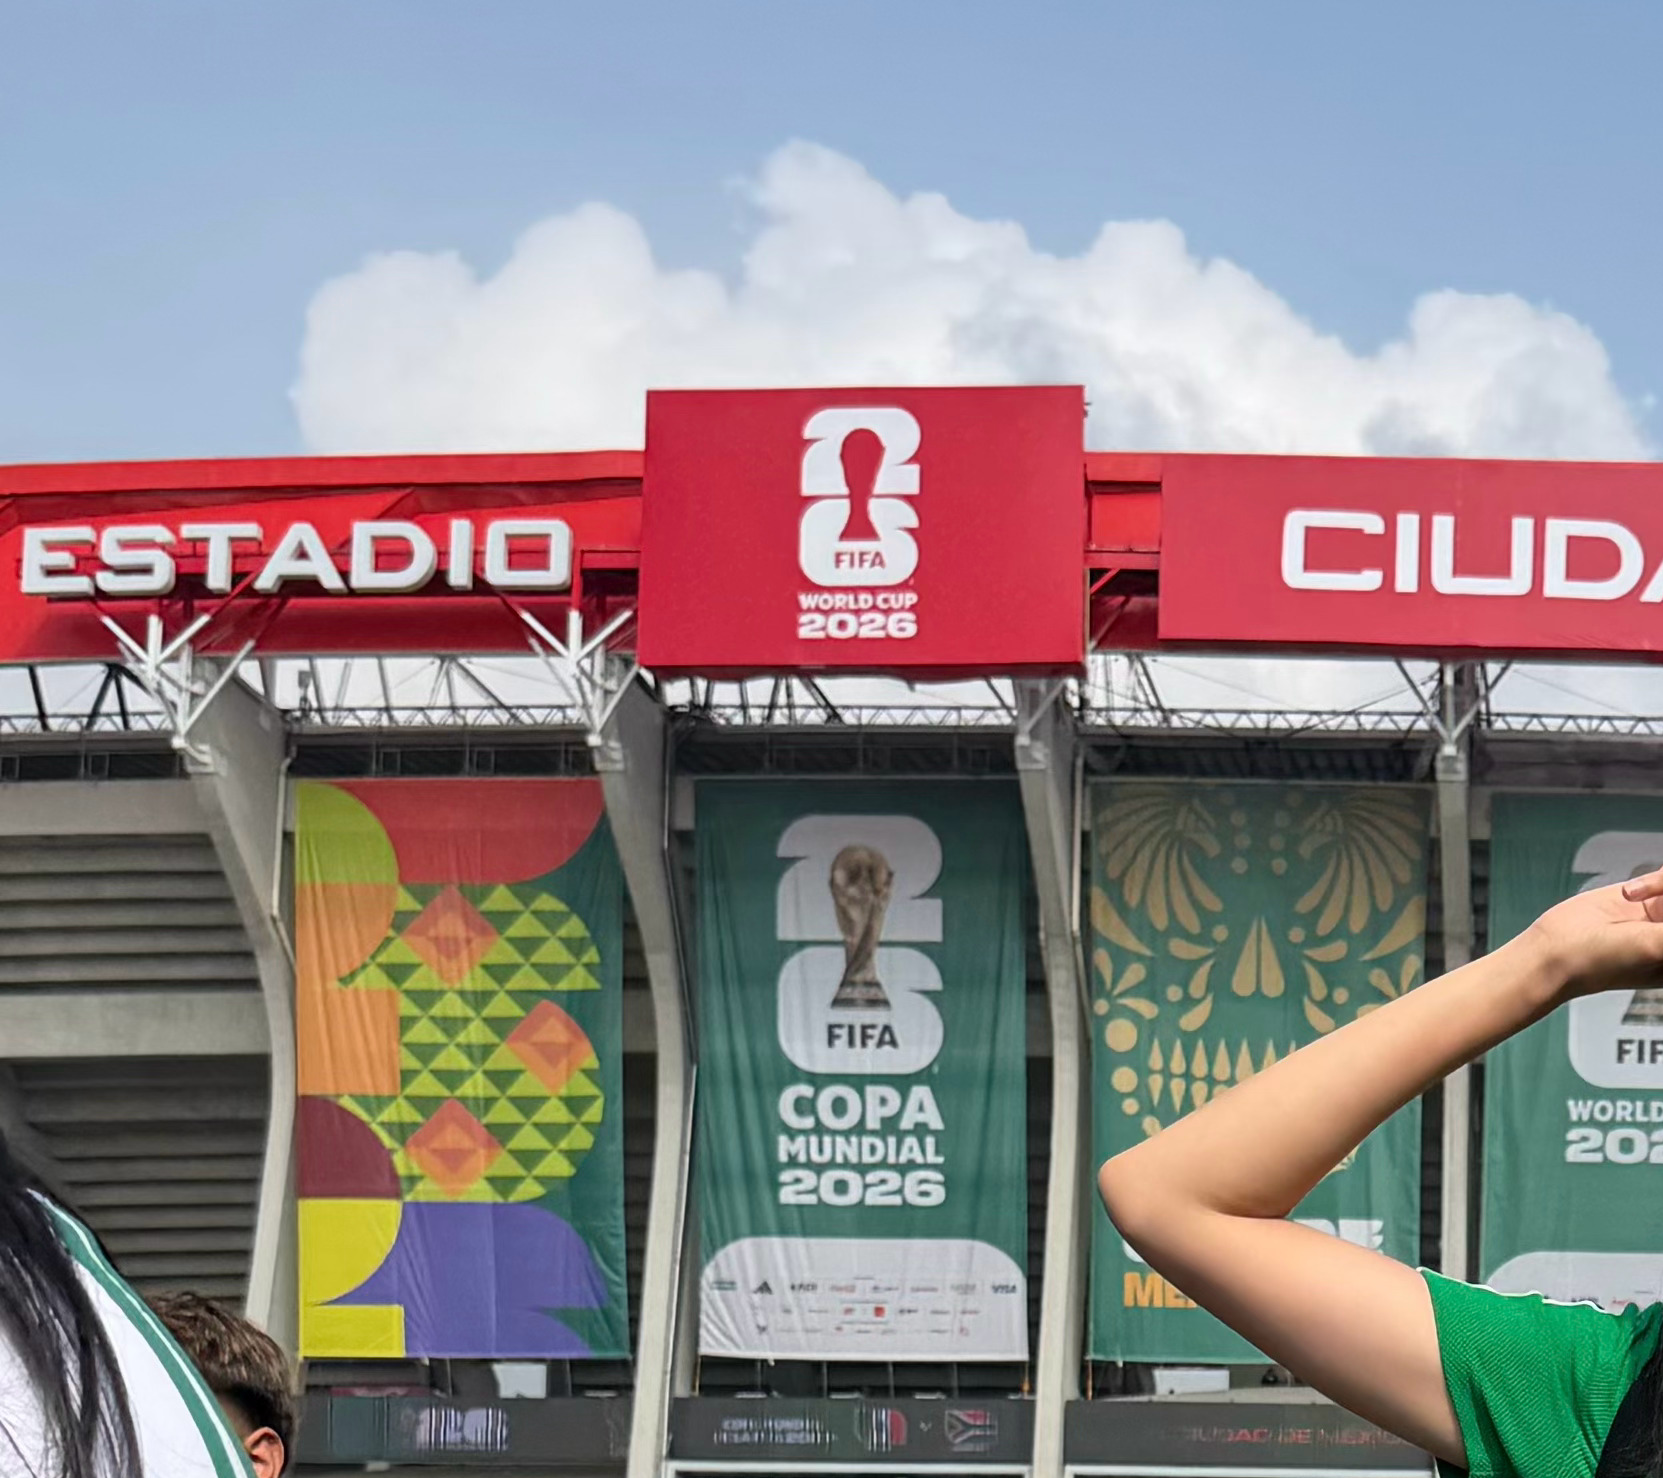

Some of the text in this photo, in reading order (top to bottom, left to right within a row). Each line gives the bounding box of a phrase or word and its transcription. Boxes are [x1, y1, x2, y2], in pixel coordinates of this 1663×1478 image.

[20, 518, 573, 598] ESTADIO
[834, 551, 886, 569] FIFA
[798, 592, 919, 610] WORLD CUP
[798, 612, 918, 639] 2026
[826, 1023, 899, 1050] FIFA
[778, 1083, 945, 1131] COPA
[778, 1135, 944, 1164] MUNDIAL
[778, 1169, 947, 1207] 2026
